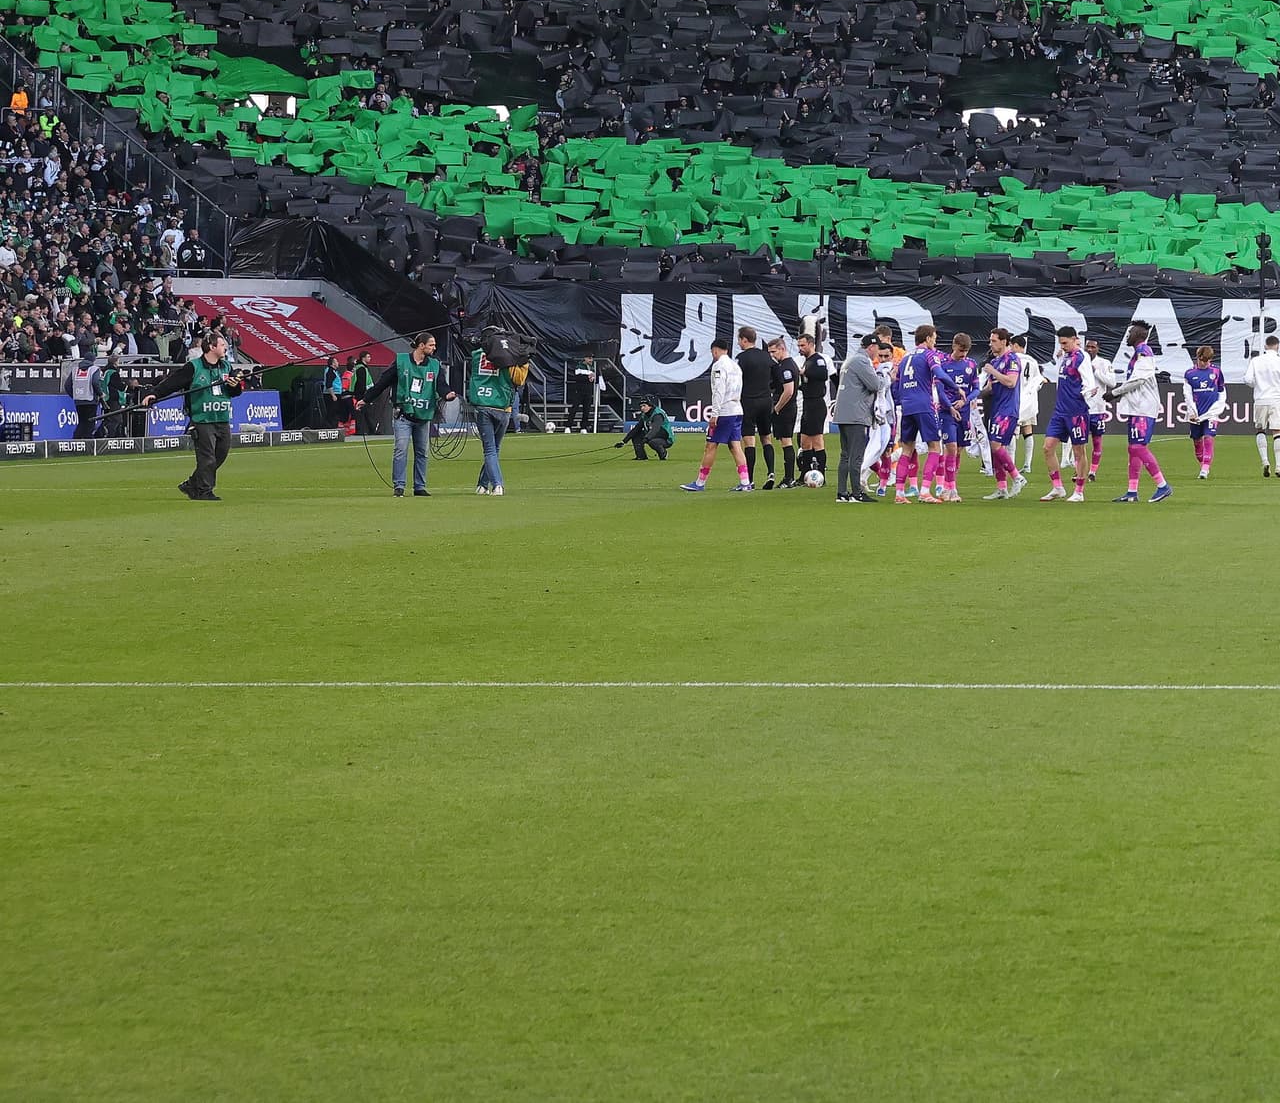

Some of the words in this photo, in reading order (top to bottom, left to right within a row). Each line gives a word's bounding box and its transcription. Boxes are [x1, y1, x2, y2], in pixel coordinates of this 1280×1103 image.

[620, 293, 936, 383] UND
[904, 355, 914, 380] 4
[1024, 362, 1030, 381] 4
[477, 386, 492, 397] 25
[203, 401, 231, 413] HOST
[405, 397, 430, 410] OST
[253, 405, 278, 422] sonepar
[240, 432, 264, 443] REUTER
[280, 431, 303, 442] REUTER
[318, 429, 339, 440] REUTER
[1072, 426, 1082, 439] 19
[6, 443, 35, 454] REUTER
[59, 441, 86, 452] REUTER
[108, 440, 134, 450] REUTER
[154, 438, 180, 448] REUTER
